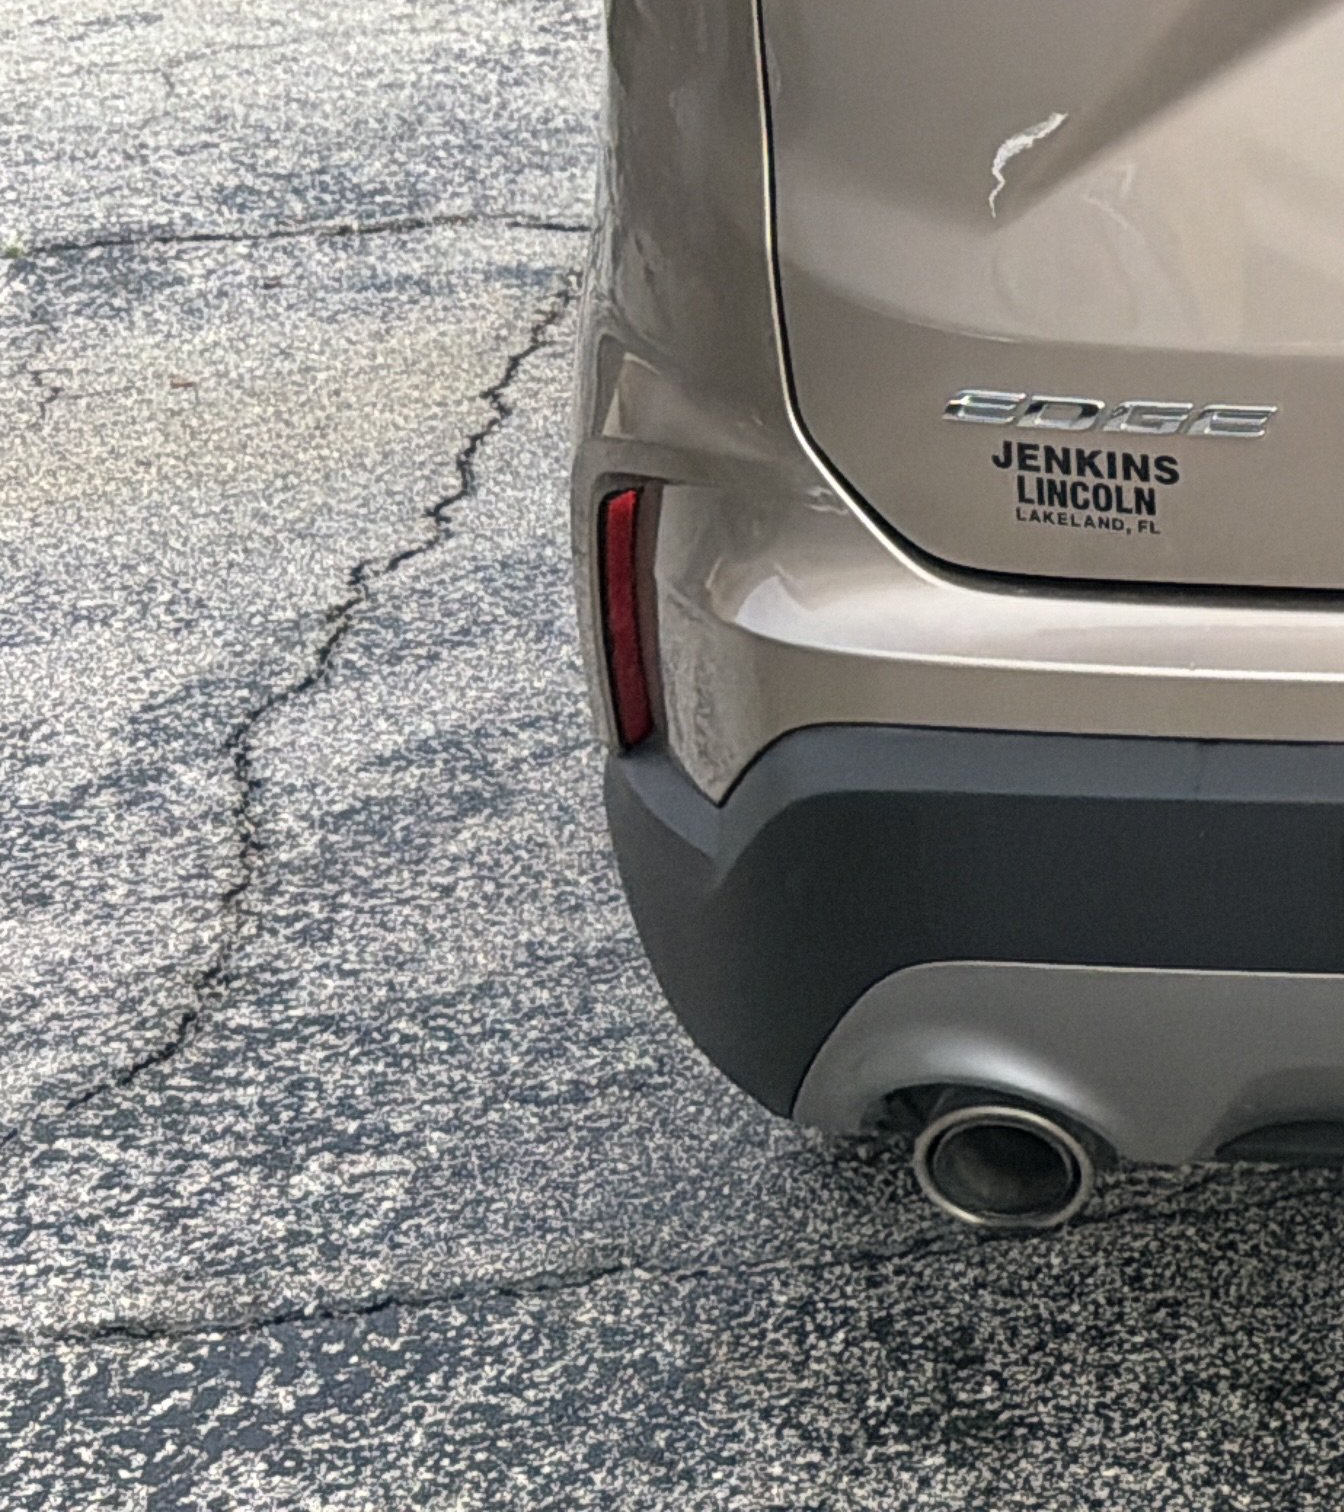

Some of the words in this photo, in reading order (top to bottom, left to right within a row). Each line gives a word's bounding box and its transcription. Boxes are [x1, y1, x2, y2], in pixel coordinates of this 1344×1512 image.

[942, 389, 1278, 439] EDGE
[992, 441, 1180, 485] JENKINS
[1016, 475, 1157, 516] LINCOLN
[1016, 507, 1132, 535] LAKELAND,
[1138, 520, 1161, 535] FL
